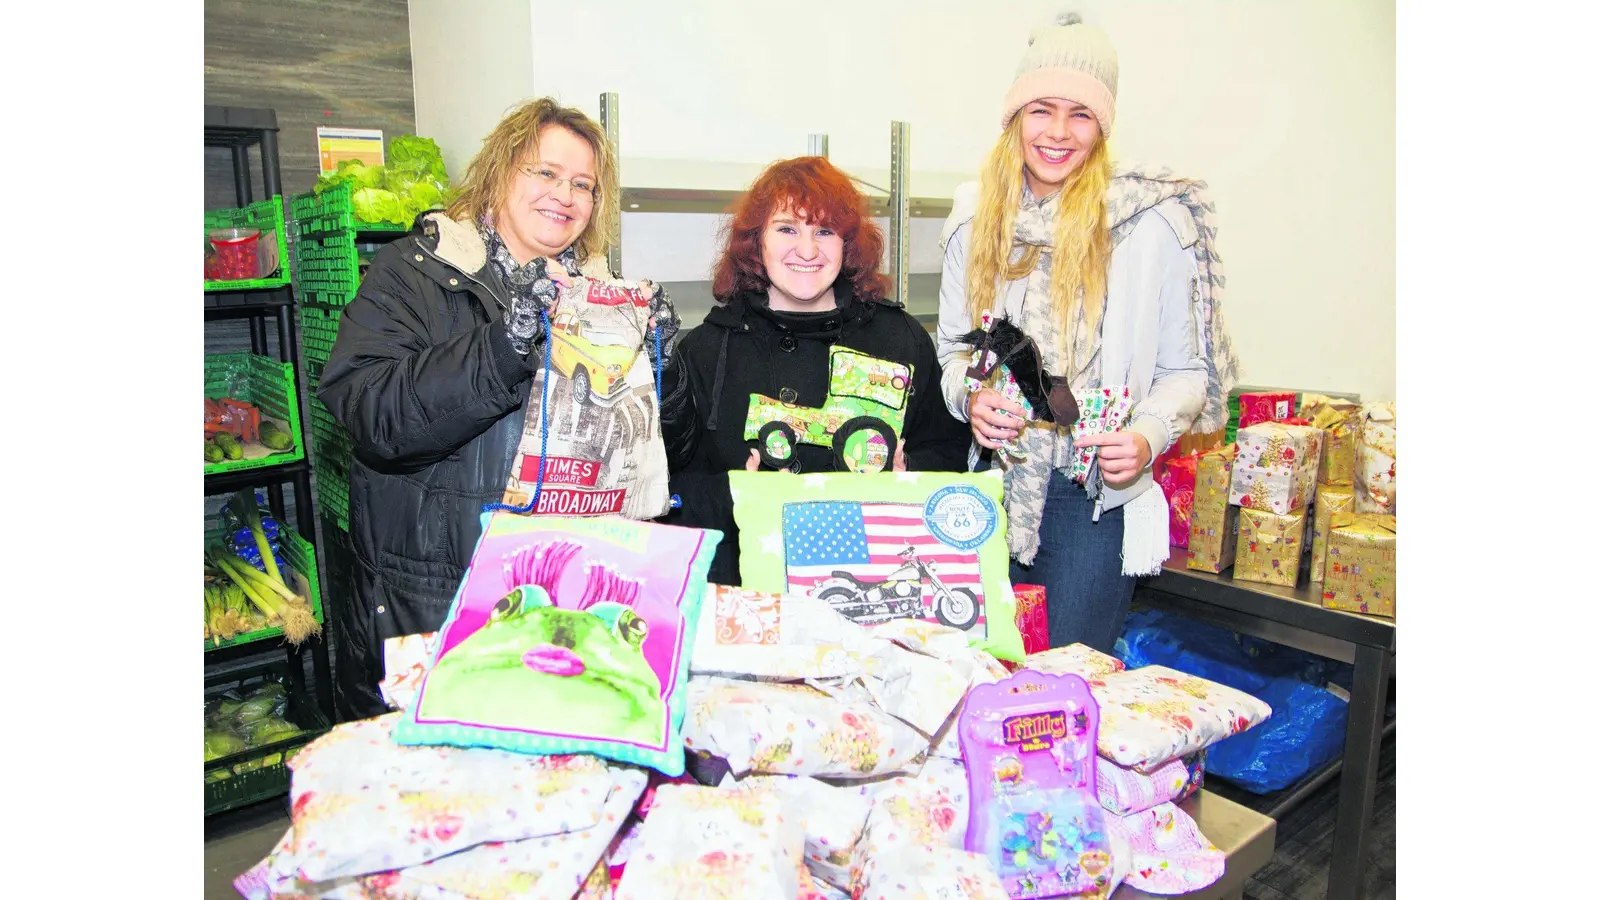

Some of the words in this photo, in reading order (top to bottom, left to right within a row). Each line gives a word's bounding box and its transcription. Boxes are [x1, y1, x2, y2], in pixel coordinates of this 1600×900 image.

[545, 458, 593, 477] TIMES
[548, 474, 582, 484] SQUARE
[537, 491, 621, 513] BROADWAY
[929, 488, 949, 510] ARIZONA
[969, 488, 989, 506] MEXICO
[953, 517, 971, 528] 66
[1005, 714, 1066, 742] Filly
